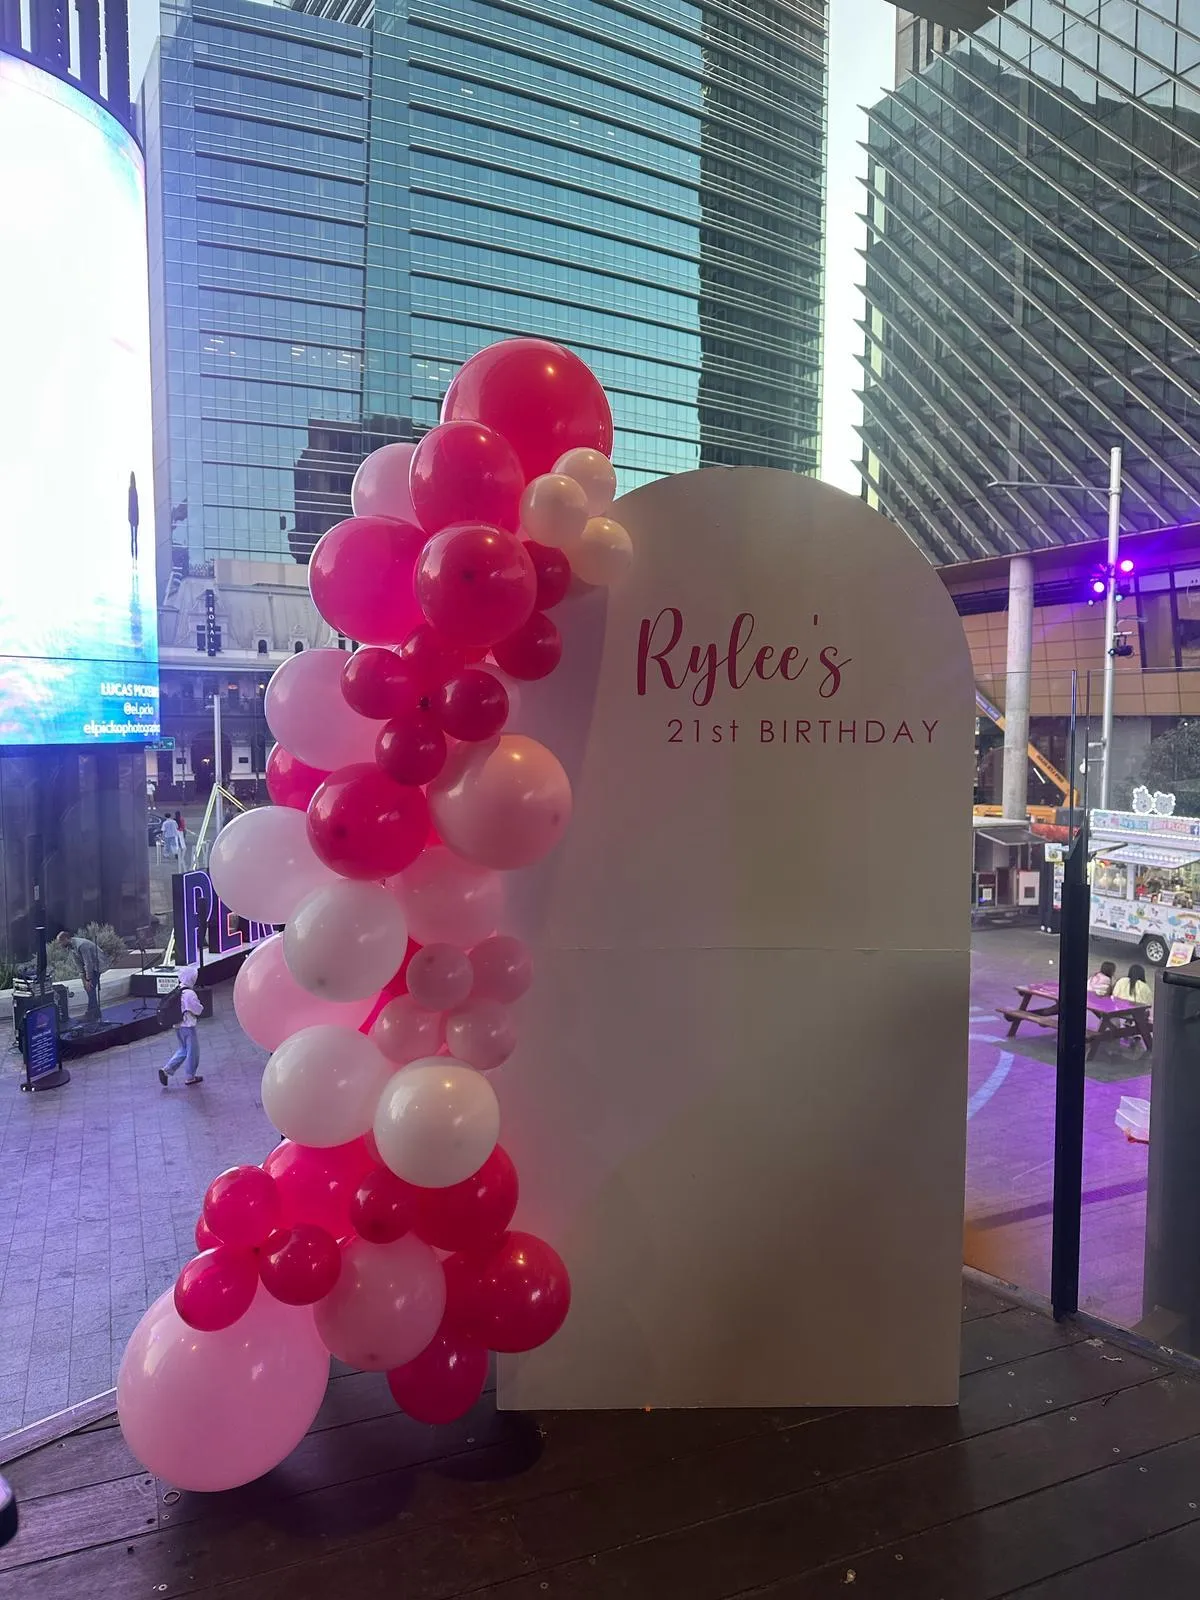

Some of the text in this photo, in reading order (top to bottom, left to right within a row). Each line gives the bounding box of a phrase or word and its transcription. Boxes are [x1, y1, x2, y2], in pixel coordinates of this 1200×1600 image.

[637, 607, 853, 707] Rylee's
[101, 683, 133, 697] LUCAS
[667, 719, 940, 744] 21st BIRTHDAY
